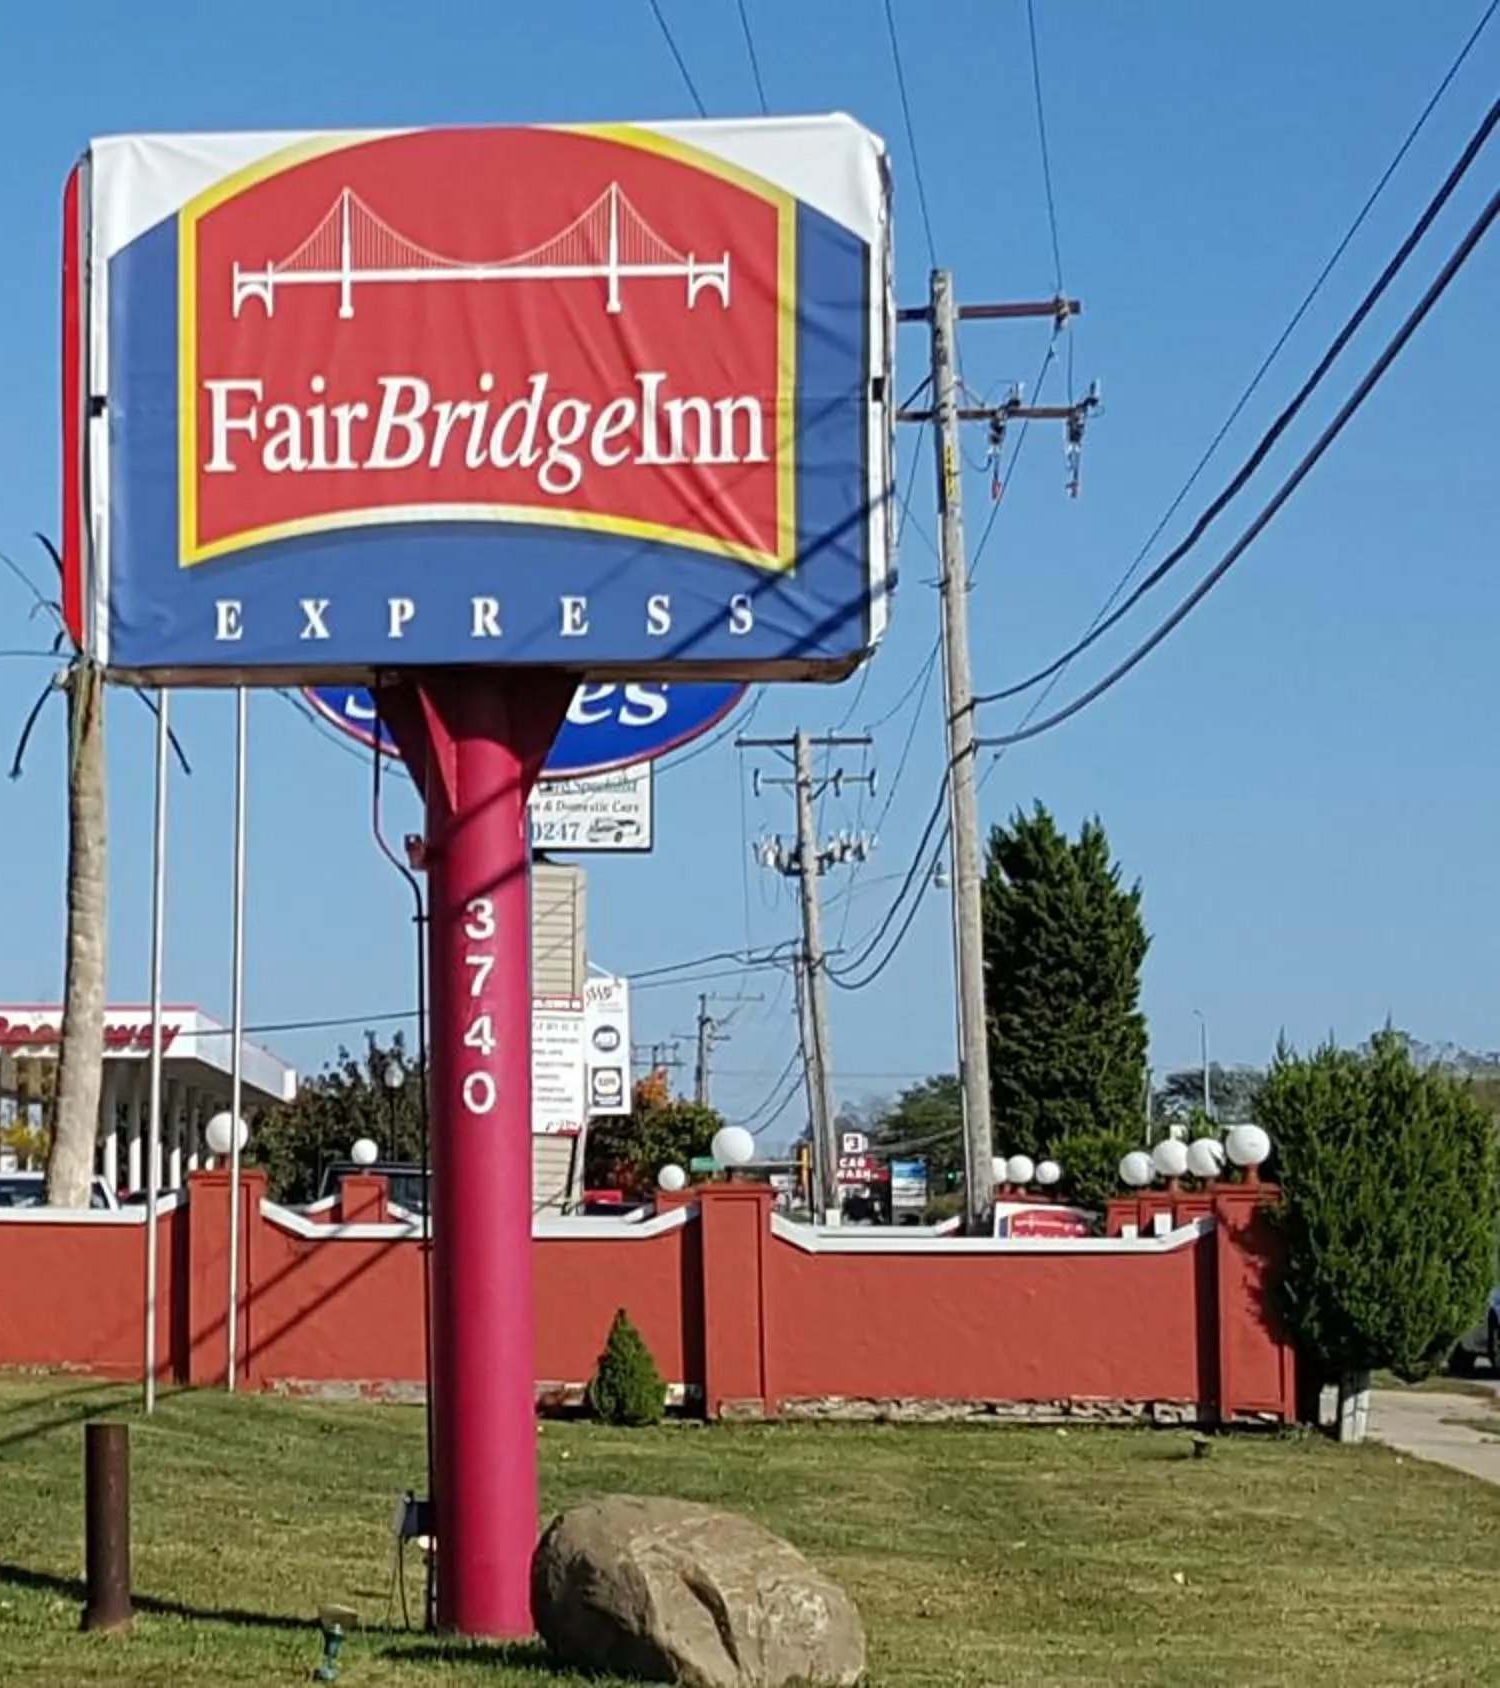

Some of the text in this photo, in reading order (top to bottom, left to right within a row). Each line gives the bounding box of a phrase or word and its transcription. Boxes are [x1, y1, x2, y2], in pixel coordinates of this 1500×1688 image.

[203, 371, 770, 494] FairBridgeInn
[214, 594, 755, 641] EXPRESS
[462, 898, 497, 1115] 3740
